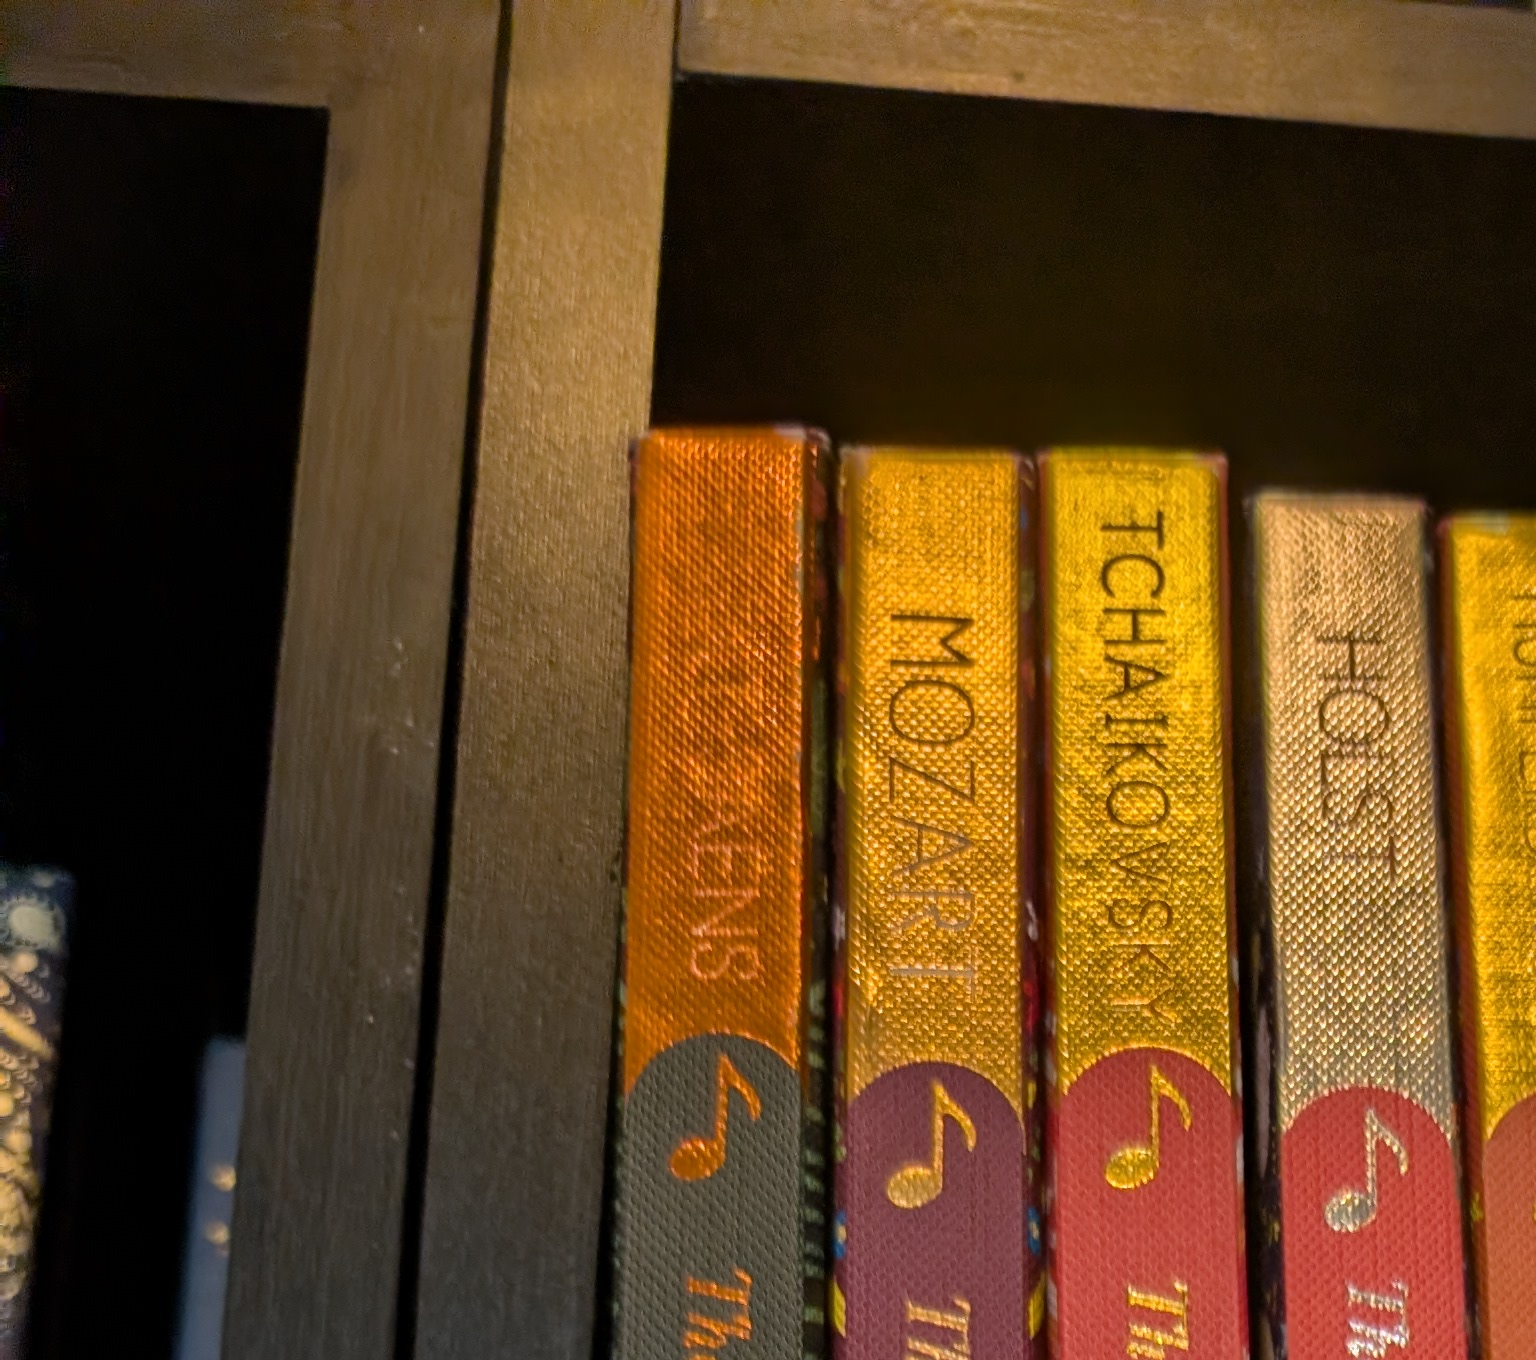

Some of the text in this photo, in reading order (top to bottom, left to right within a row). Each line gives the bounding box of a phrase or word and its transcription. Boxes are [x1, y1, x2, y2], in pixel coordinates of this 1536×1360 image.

[888, 613, 977, 1004] MOZART
[1099, 510, 1177, 1025] TCHAIKOVSKY
[1315, 633, 1399, 884] HOLST
